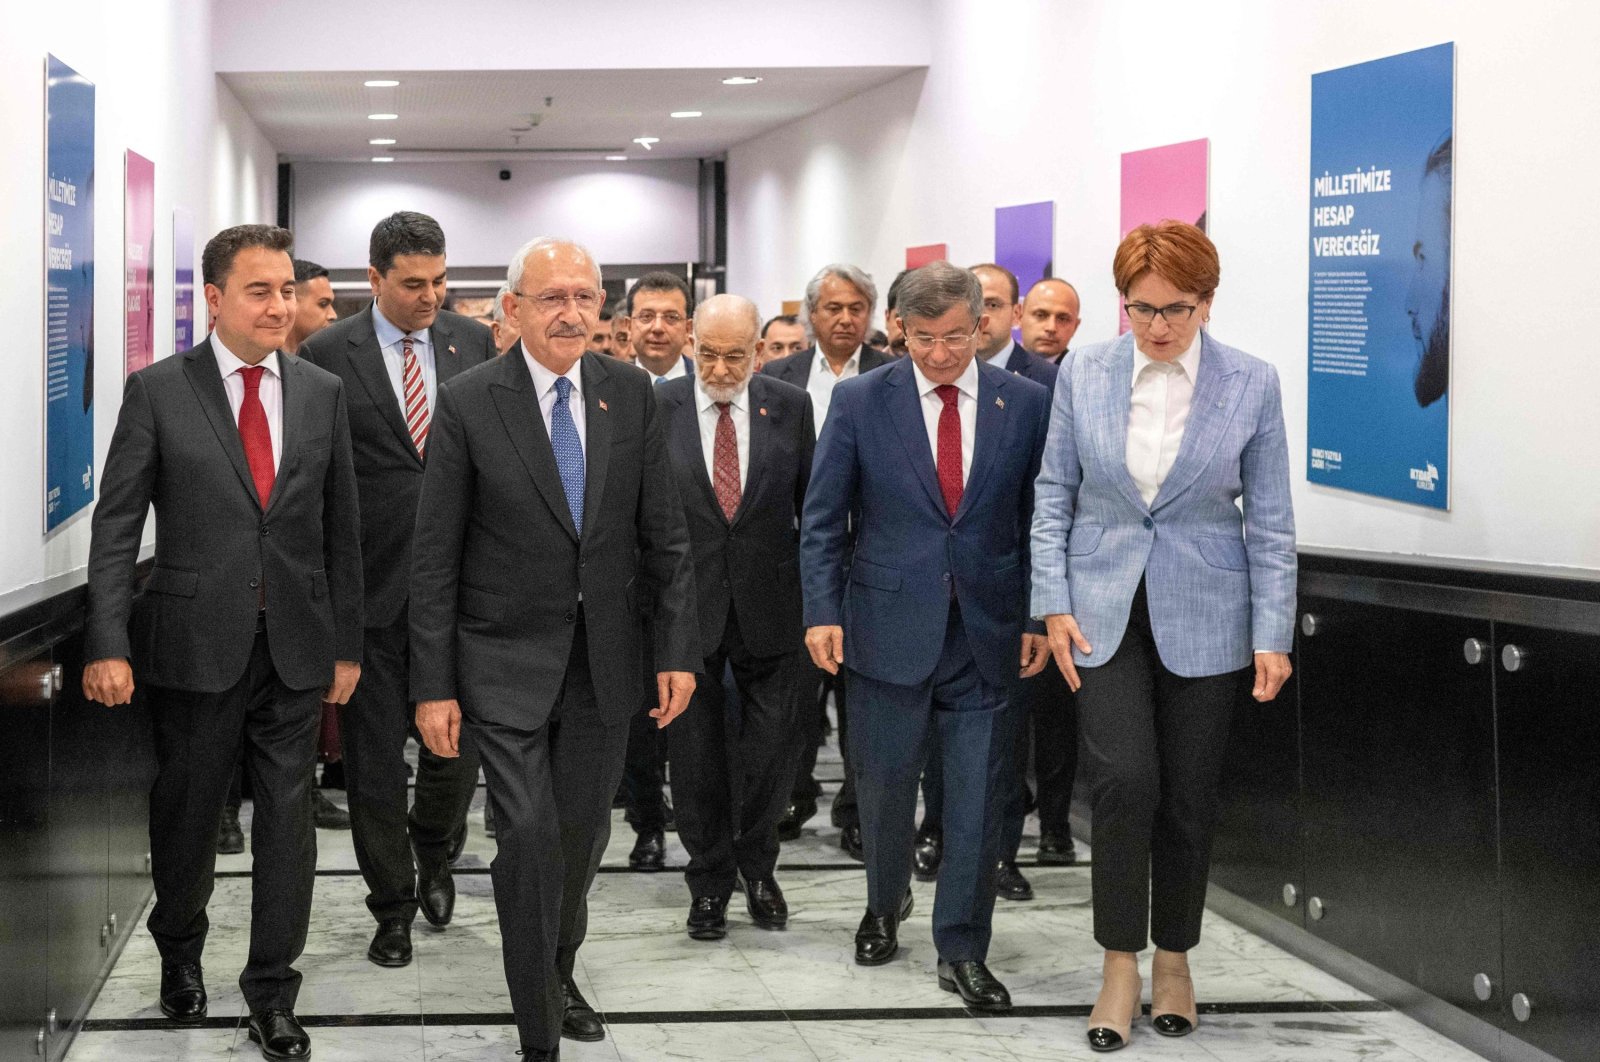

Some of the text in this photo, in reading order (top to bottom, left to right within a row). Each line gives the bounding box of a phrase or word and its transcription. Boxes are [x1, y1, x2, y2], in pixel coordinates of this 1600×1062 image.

[1314, 165, 1391, 197] MİLLETİMİZE
[1314, 205, 1354, 227] HESAP
[1313, 228, 1380, 257] VERECEĞİZ
